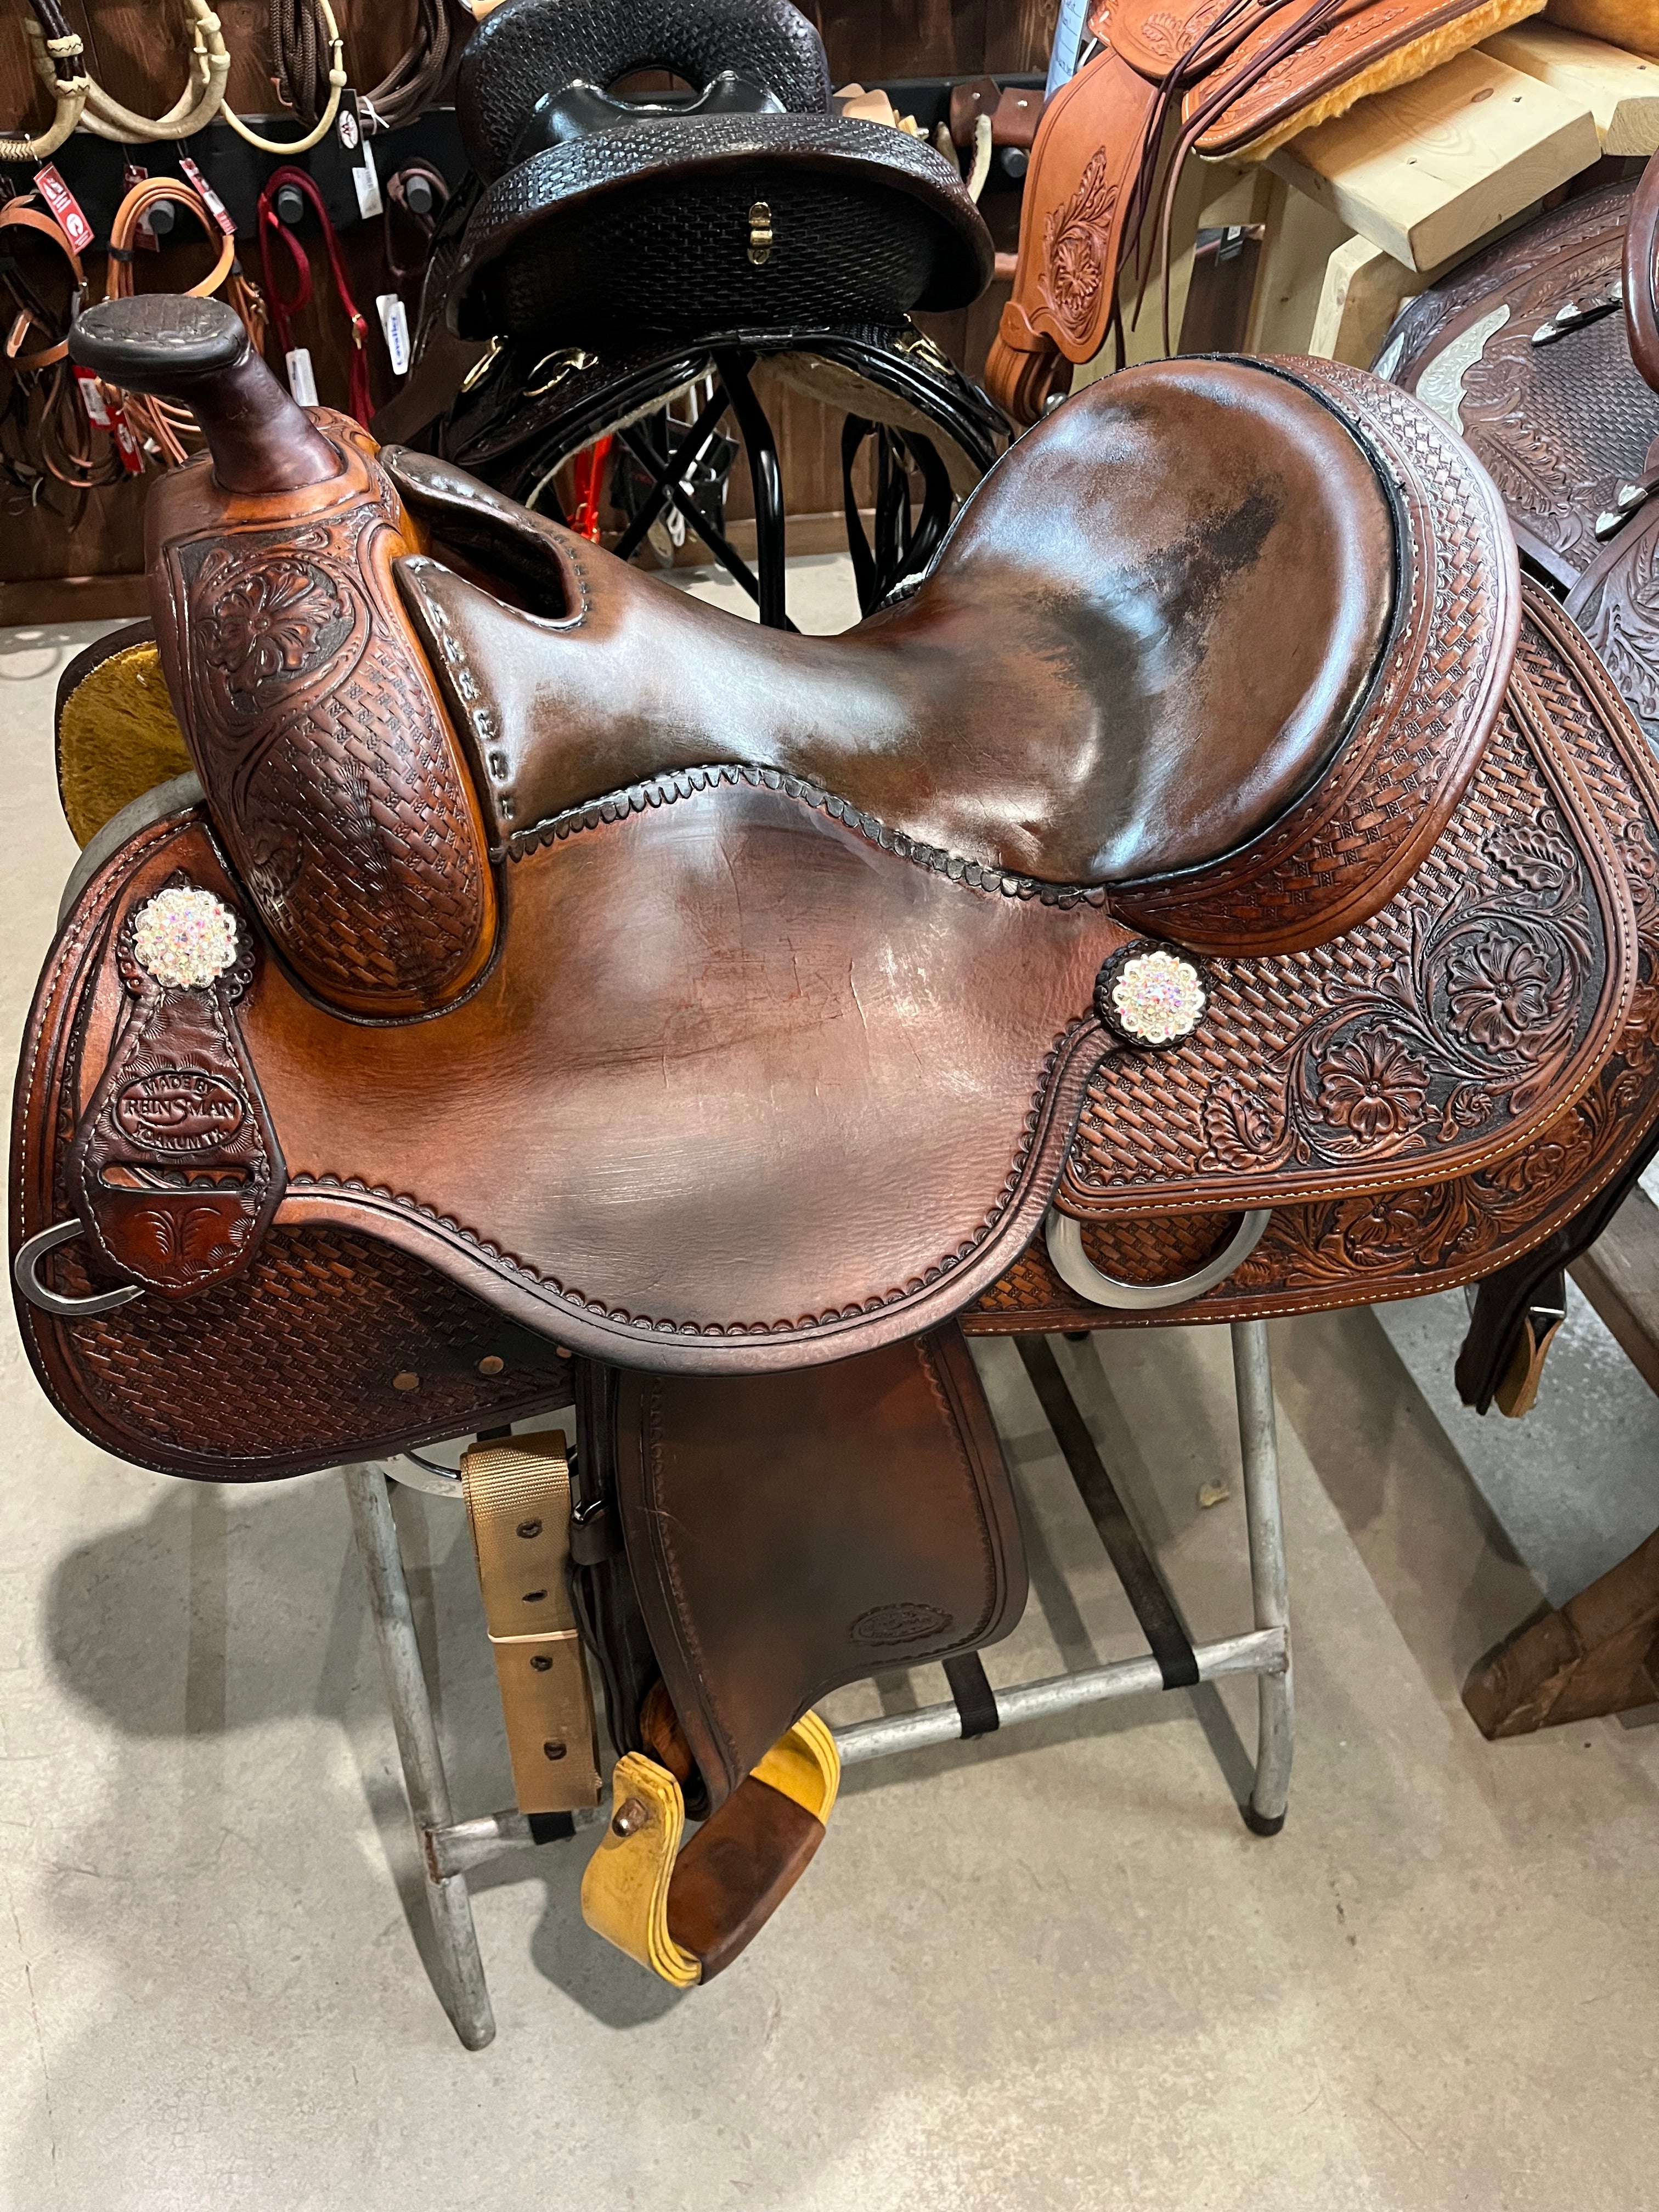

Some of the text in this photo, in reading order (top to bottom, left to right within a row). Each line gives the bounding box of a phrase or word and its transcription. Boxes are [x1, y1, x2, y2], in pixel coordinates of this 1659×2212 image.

[144, 1074, 215, 1096] MADE BY
[122, 1099, 237, 1124] REINSMAN
